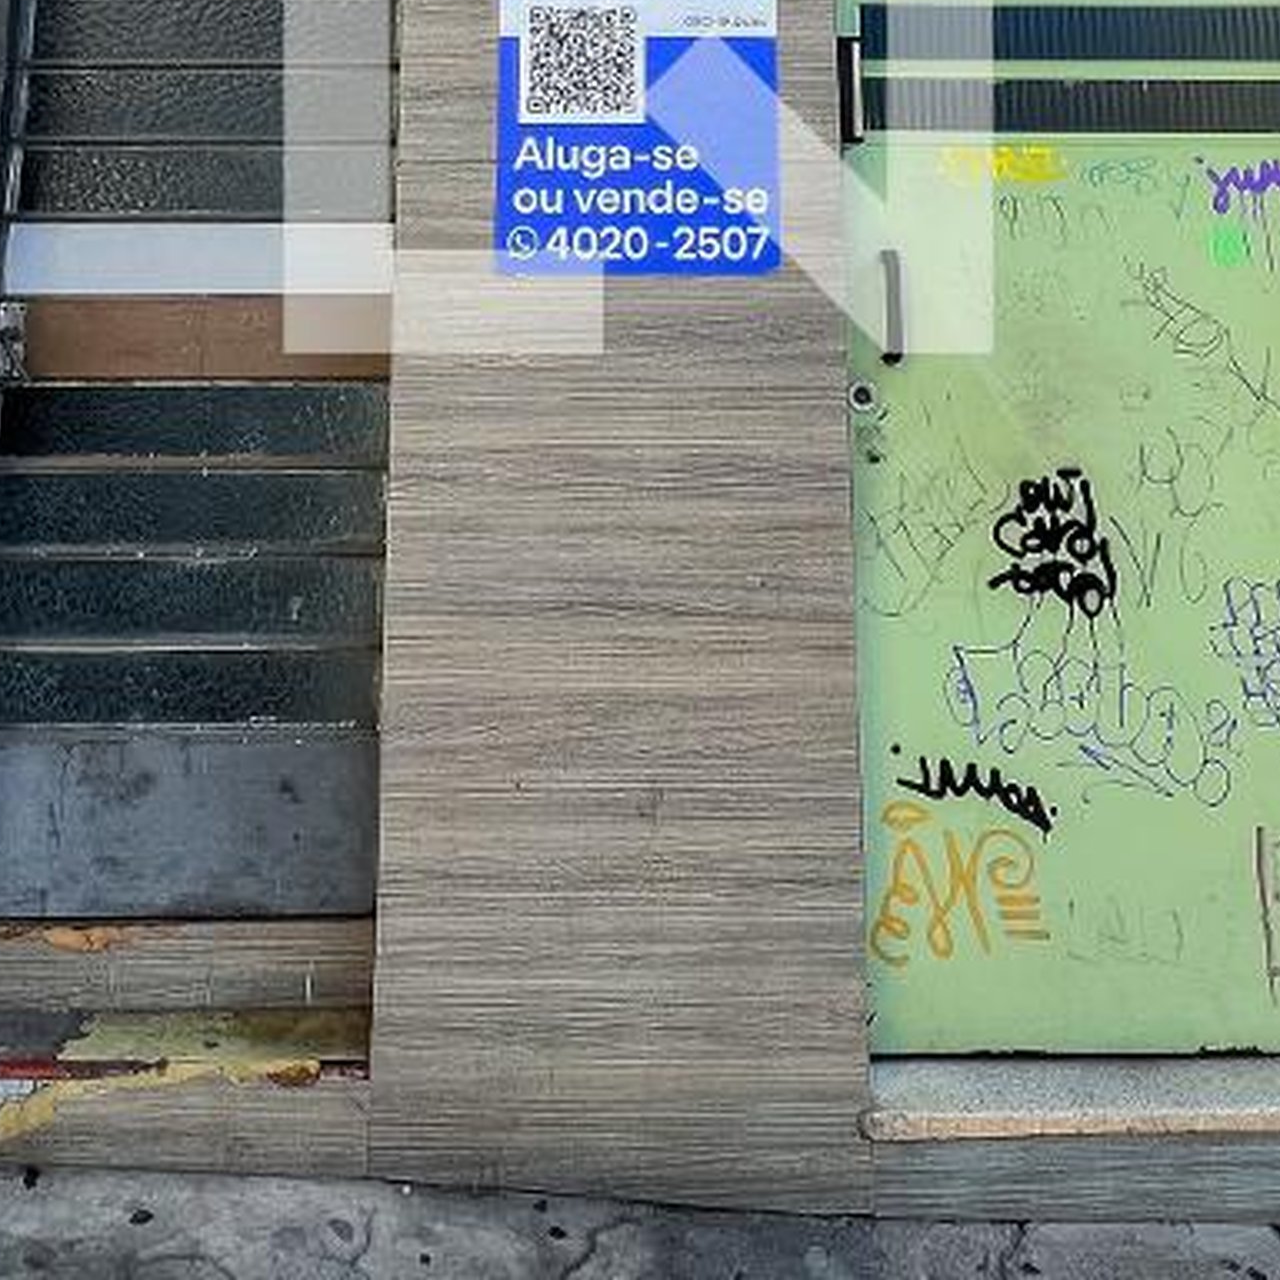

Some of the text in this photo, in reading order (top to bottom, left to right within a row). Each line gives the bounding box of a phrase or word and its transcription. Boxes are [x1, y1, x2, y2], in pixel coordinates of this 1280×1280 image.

[513, 136, 699, 178] Aluga-se
[513, 179, 769, 215] ou vende-se
[545, 227, 770, 260] 4020-2507
